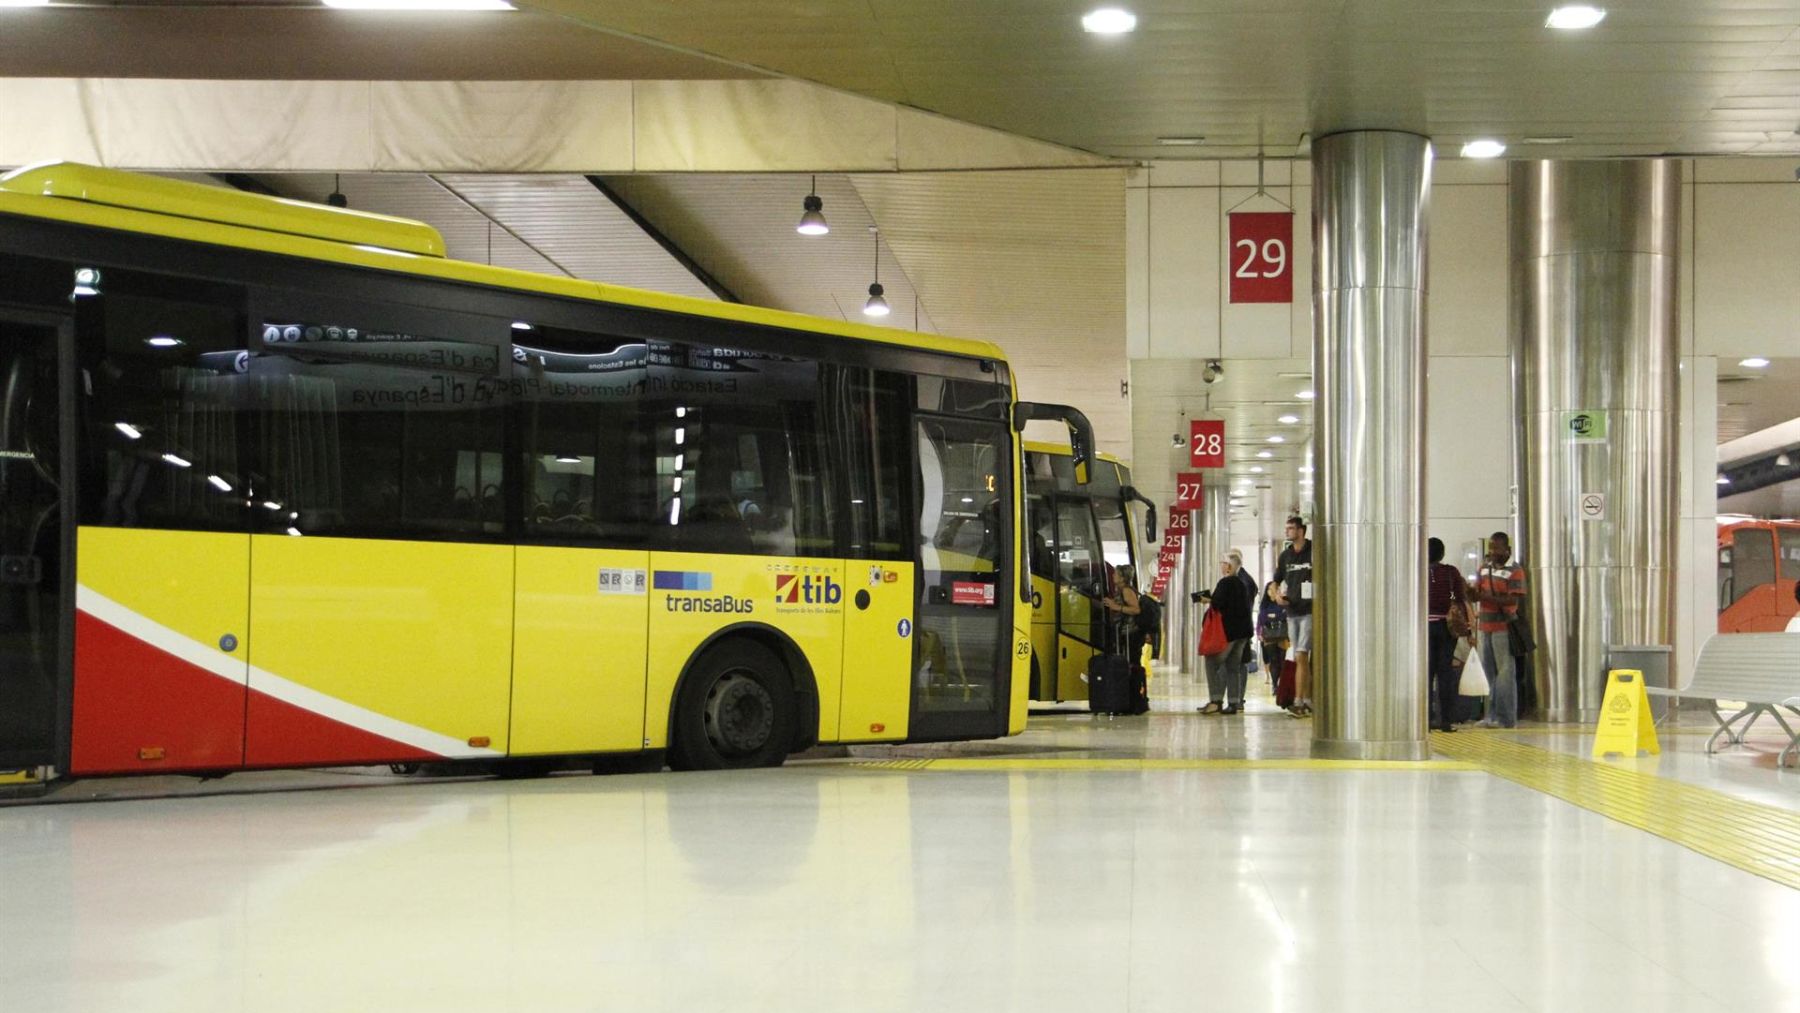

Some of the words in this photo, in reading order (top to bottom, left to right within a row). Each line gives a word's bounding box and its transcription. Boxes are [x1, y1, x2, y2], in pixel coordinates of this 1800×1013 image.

[1236, 238, 1286, 278] 29
[1193, 433, 1222, 456] 28
[1179, 483, 1201, 500] 27
[1171, 514, 1189, 528] 26
[1166, 535, 1181, 547] 25
[1161, 551, 1174, 562] 24
[802, 574, 842, 604] tib
[666, 593, 754, 613] transaBus
[1017, 642, 1029, 655] 26
